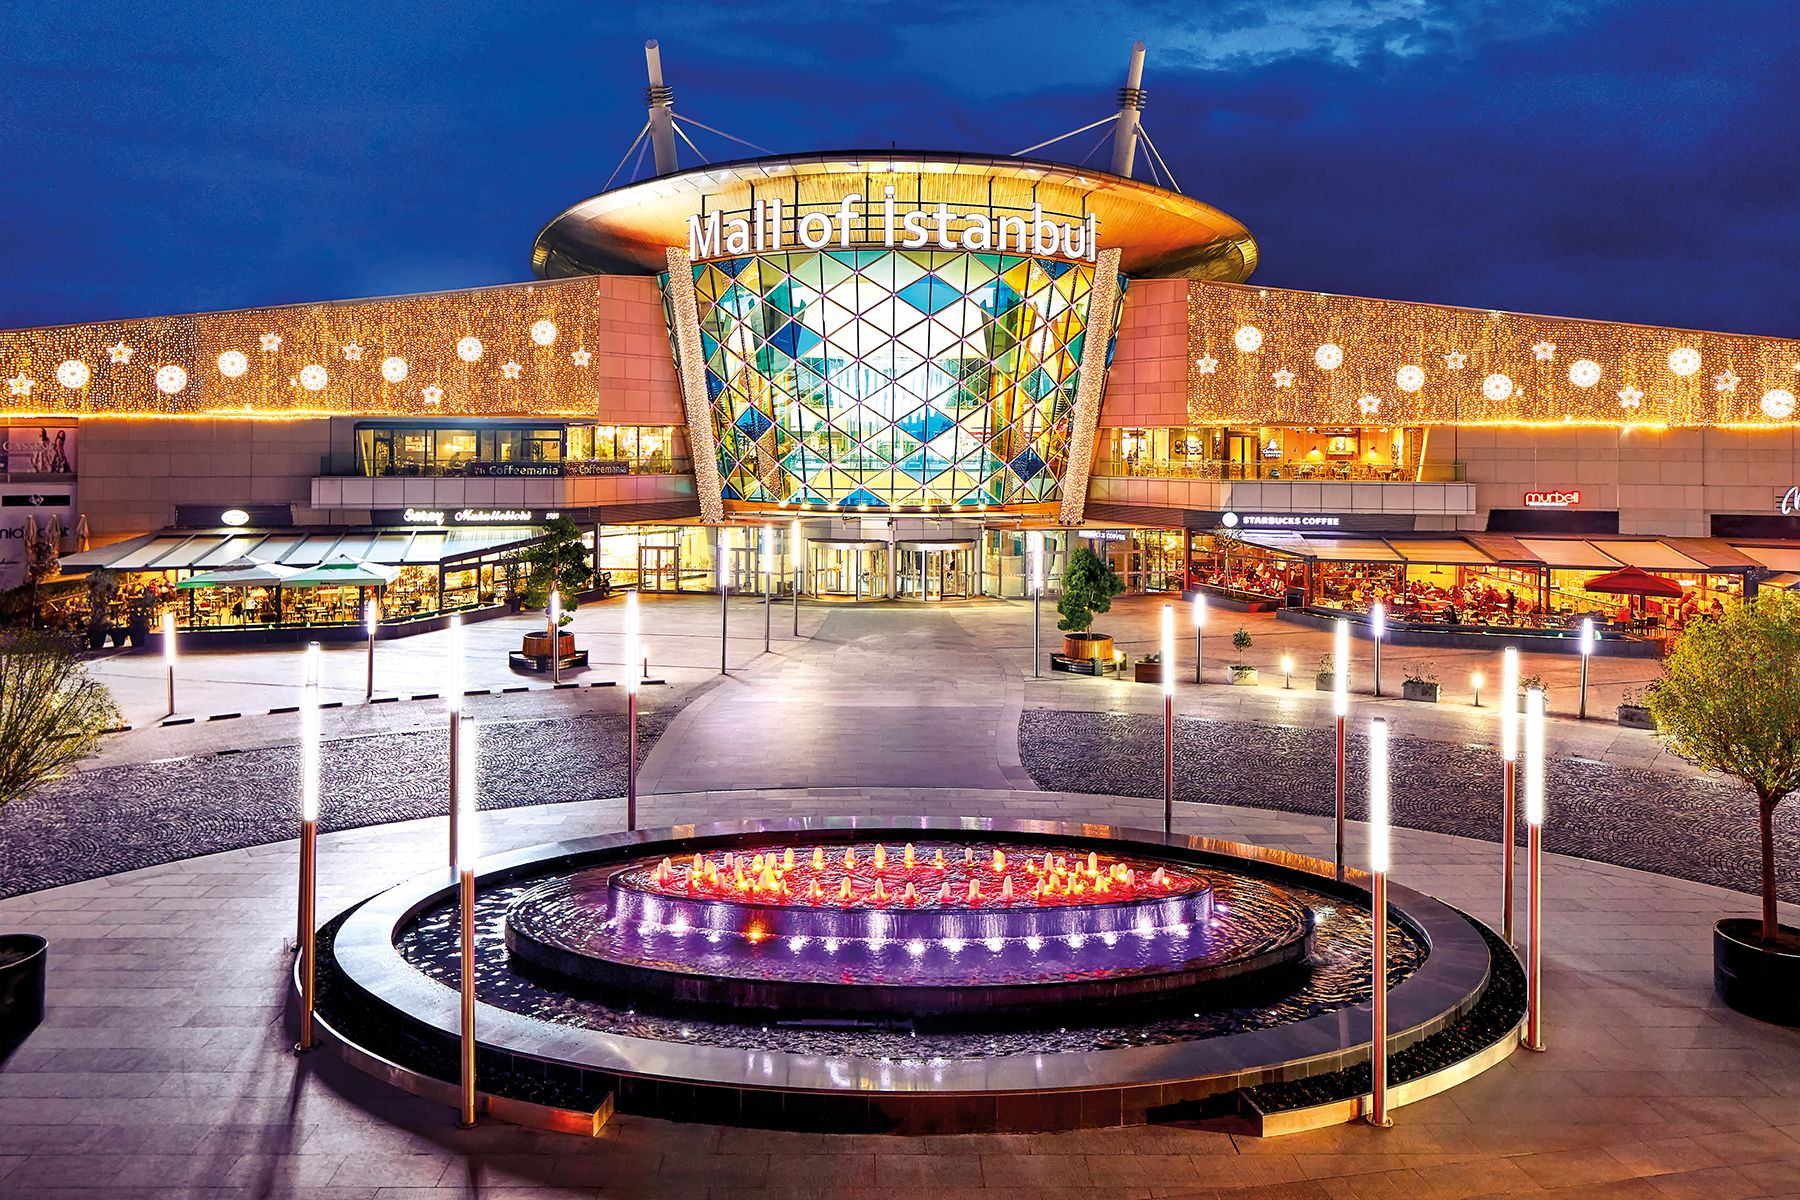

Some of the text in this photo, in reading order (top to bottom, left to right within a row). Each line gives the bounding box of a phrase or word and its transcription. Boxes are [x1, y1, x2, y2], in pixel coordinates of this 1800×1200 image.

[689, 198, 783, 261] Mall
[799, 193, 861, 250] of
[489, 465, 559, 475] Coffeemania
[579, 464, 627, 475] Coffeemania
[1525, 491, 1579, 505] murbell
[1243, 516, 1340, 526] STARBUCKS COFFEE
